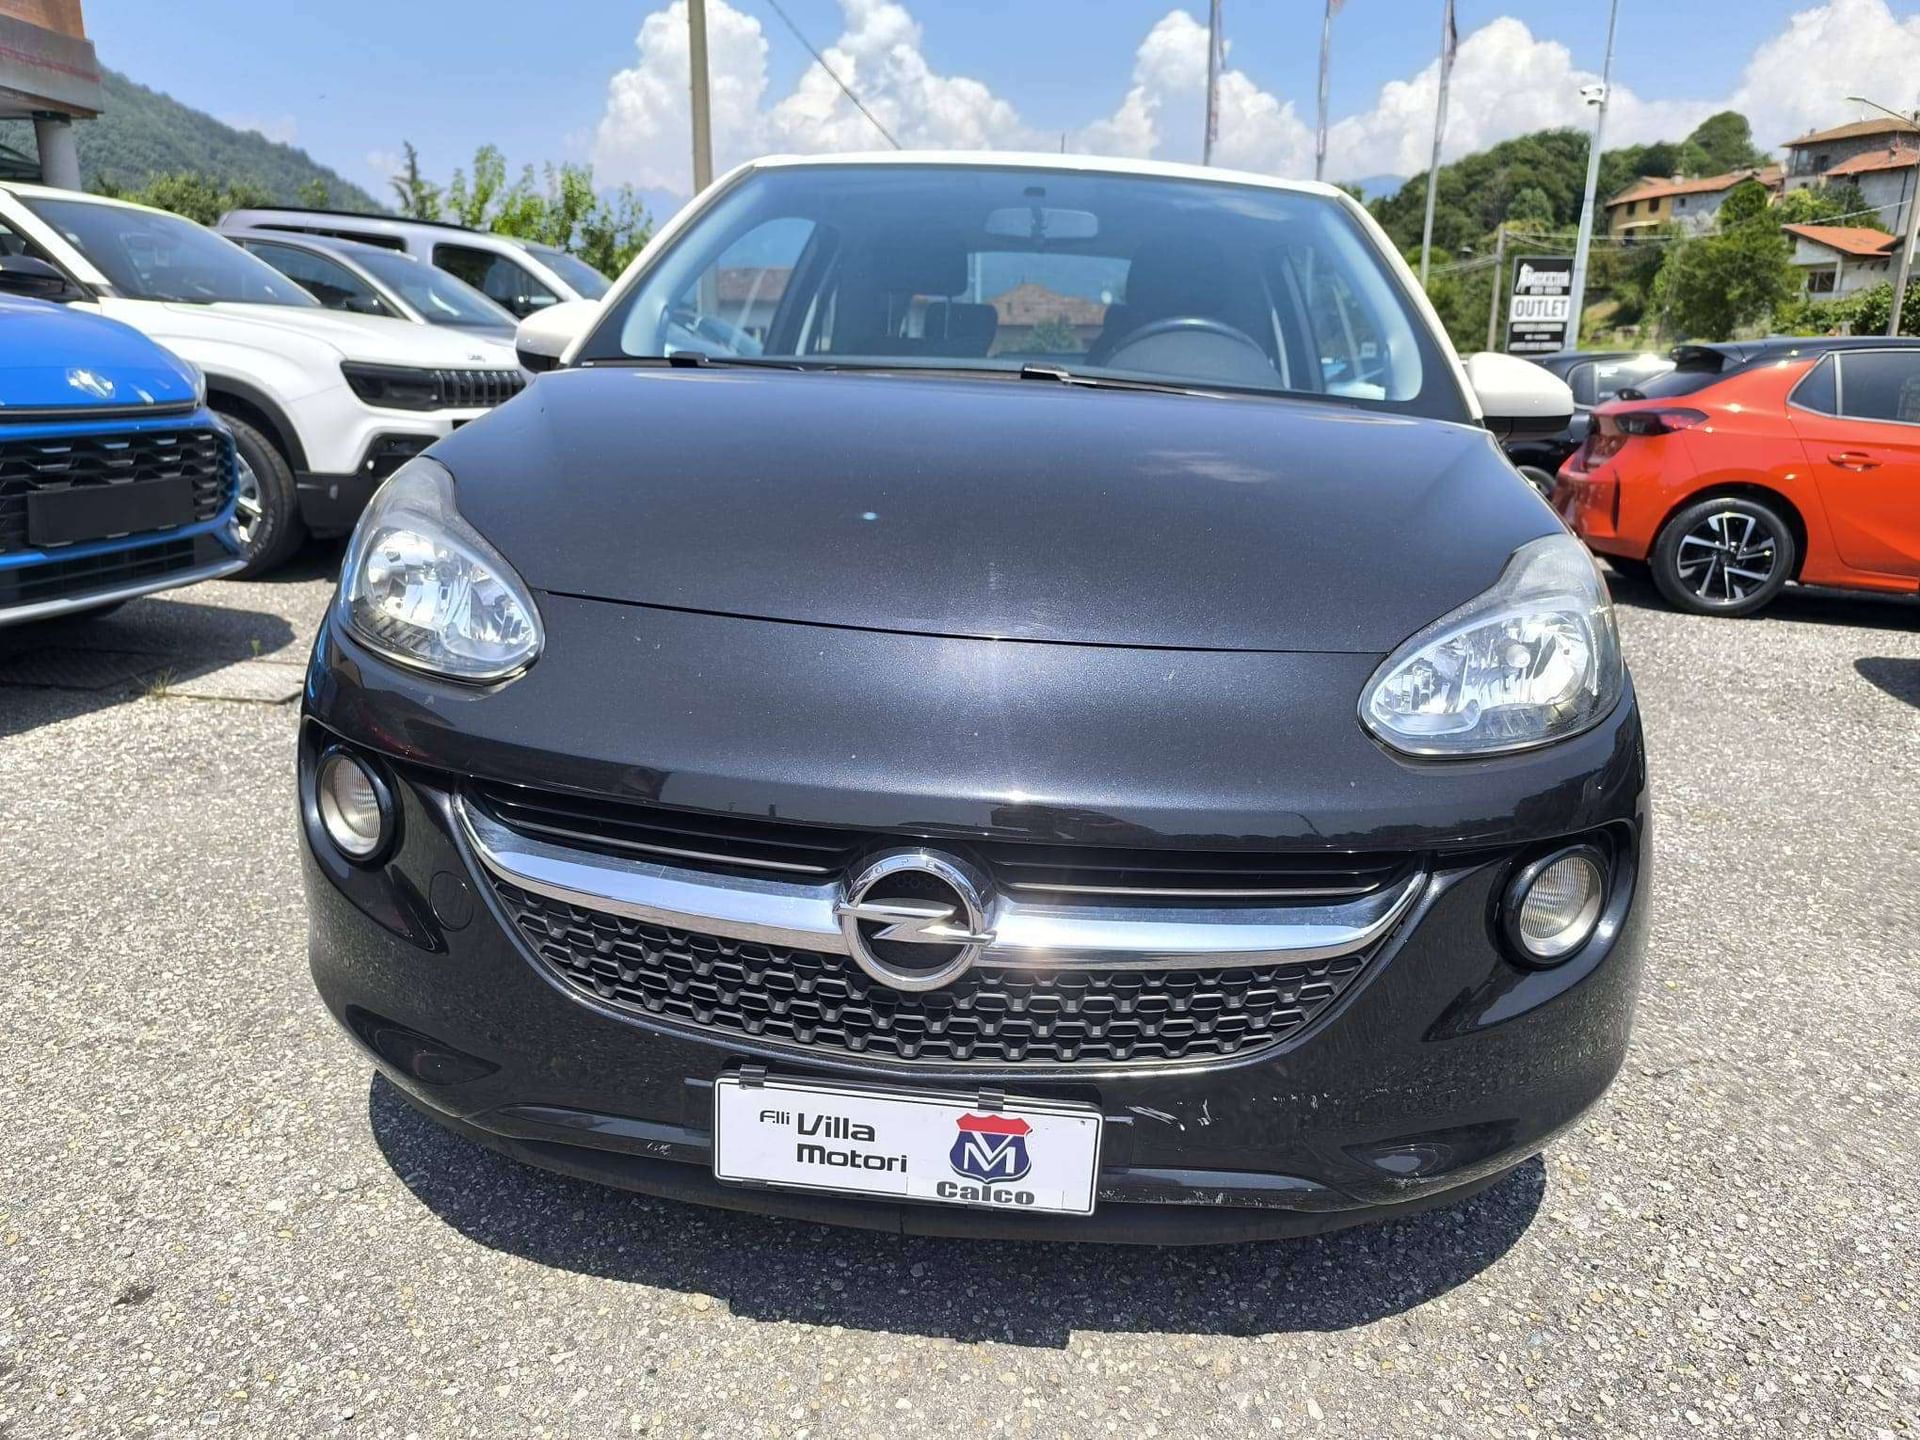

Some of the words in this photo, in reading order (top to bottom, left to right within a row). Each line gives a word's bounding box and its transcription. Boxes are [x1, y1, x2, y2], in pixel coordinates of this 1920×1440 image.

[1515, 300, 1567, 317] OUTLET
[797, 1112, 875, 1142] Villa
[796, 1142, 907, 1173] Motori
[936, 1180, 1035, 1205] Calco
